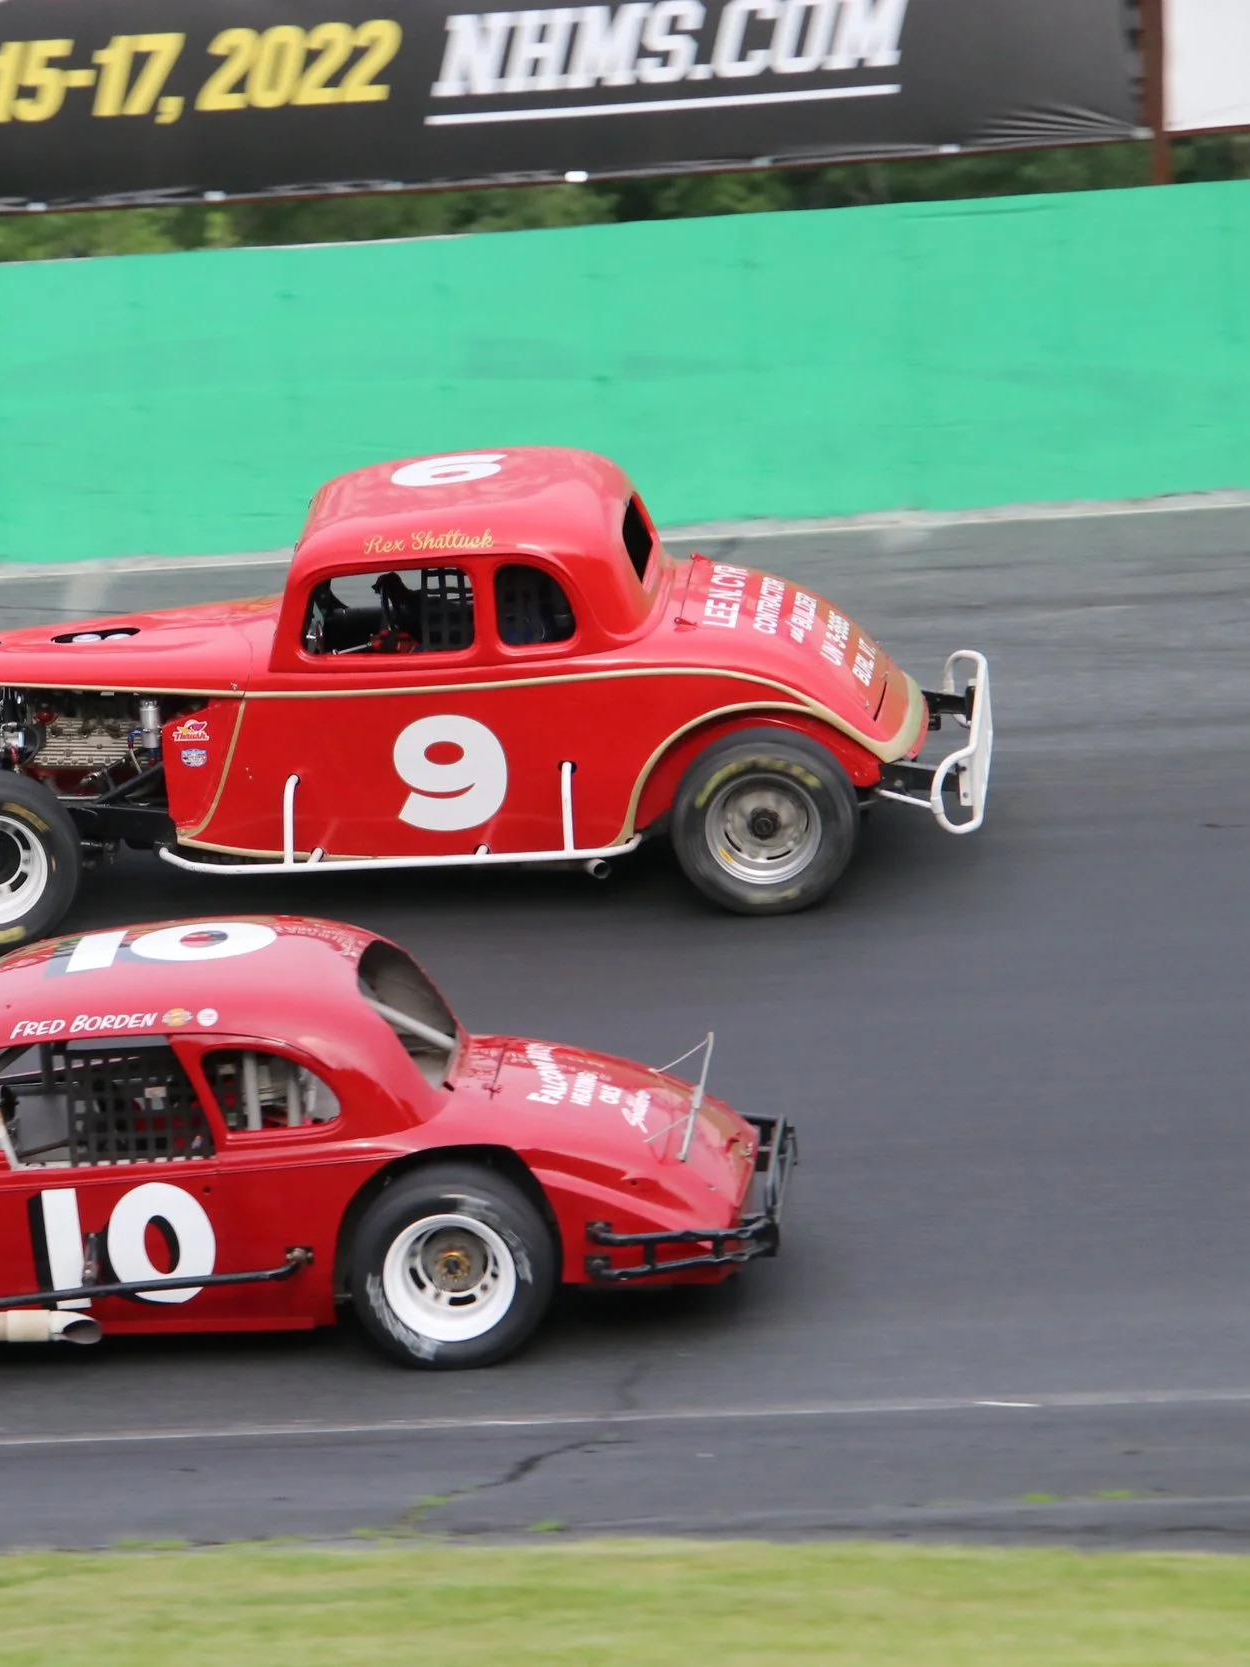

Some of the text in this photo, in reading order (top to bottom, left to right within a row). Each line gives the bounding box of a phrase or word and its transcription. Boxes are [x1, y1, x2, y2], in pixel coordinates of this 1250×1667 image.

[195, 20, 403, 112] 2022
[431, 0, 902, 98] NHMS.COM
[363, 528, 495, 555] Rex Shattuck
[709, 564, 749, 588] CYR
[702, 599, 741, 629] LEE
[752, 576, 786, 635] CONTRACTOR
[790, 591, 818, 632] BUILDER
[392, 713, 509, 832] 9
[65, 921, 278, 973] 10
[9, 1019, 65, 1040] FRED
[69, 1011, 159, 1034] BORDEN
[40, 1181, 217, 1310] 10
